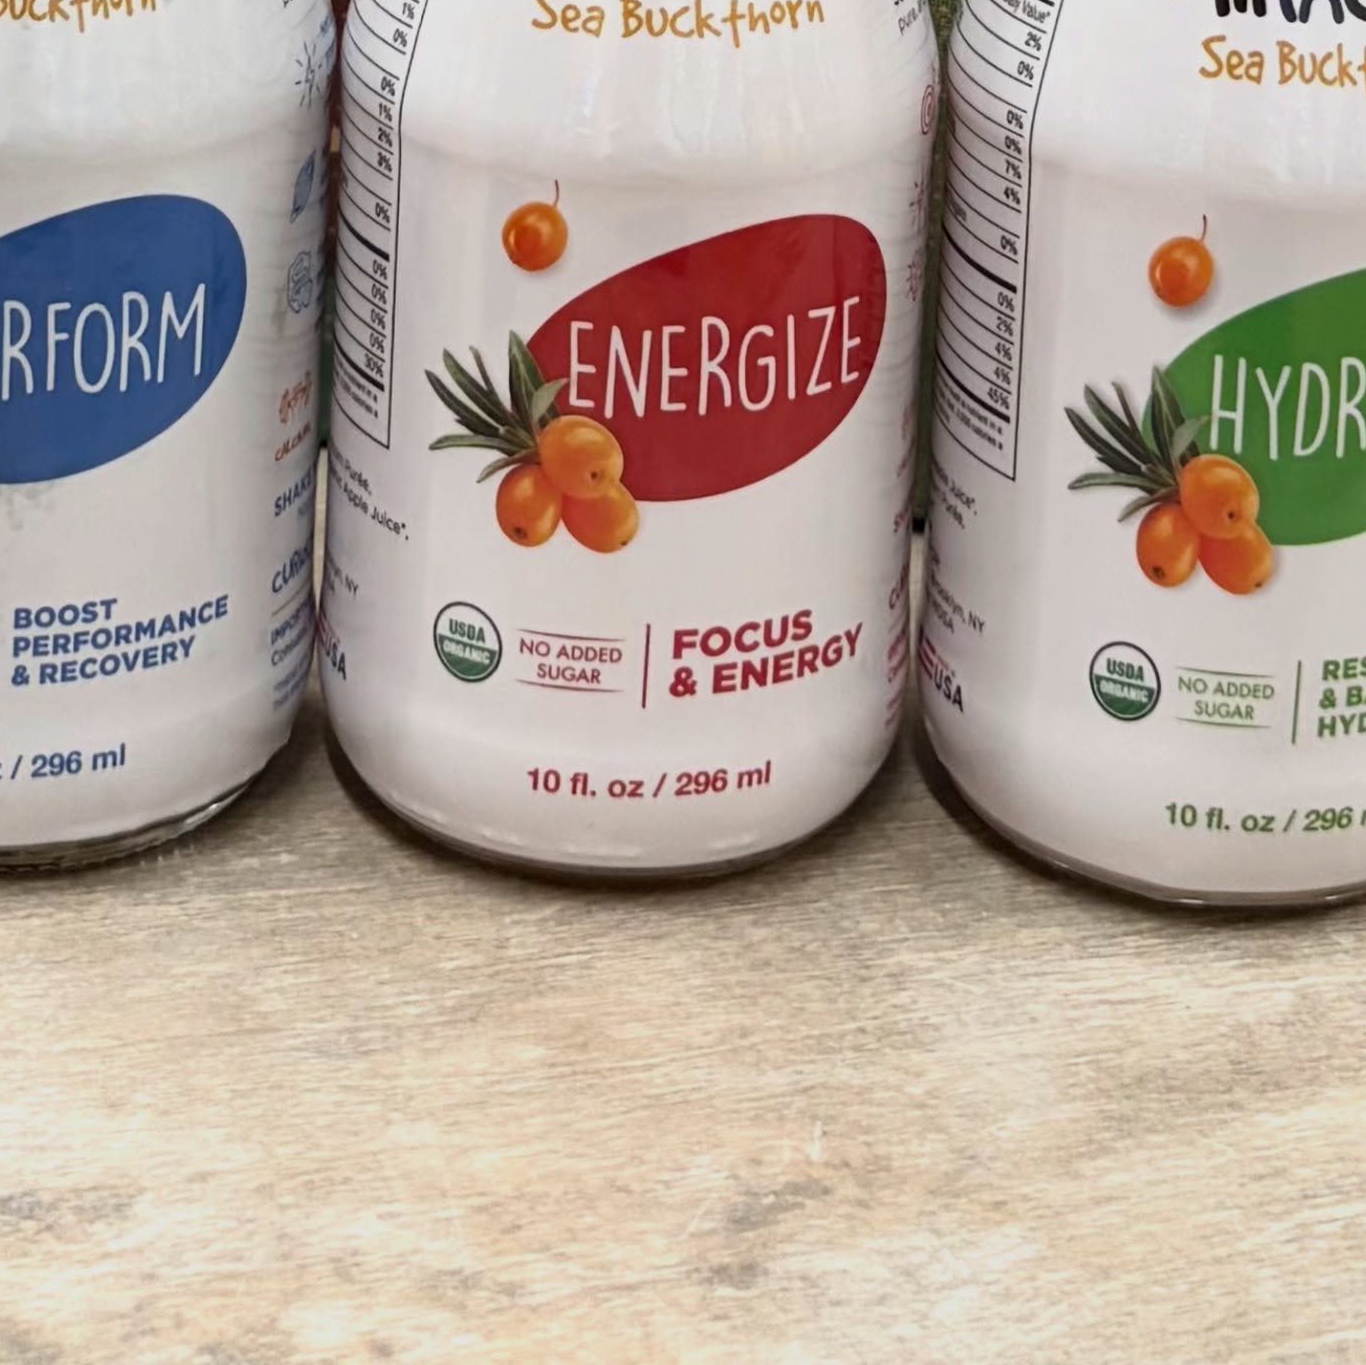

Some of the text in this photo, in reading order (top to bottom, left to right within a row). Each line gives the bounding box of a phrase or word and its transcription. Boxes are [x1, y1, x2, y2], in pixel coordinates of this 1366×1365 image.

[402, 0, 415, 21] 1%
[392, 27, 408, 48] 0%
[1024, 31, 1042, 52] 2%
[1017, 60, 1035, 81] 0%
[1199, 35, 1263, 86] Sea
[380, 75, 396, 97] 0%
[1006, 109, 1024, 130] 0%
[1004, 135, 1022, 156] 0%
[1004, 159, 1022, 180] 7%
[1003, 186, 1021, 206] 4%
[375, 201, 390, 224] 0%
[1000, 235, 1018, 256] 0%
[372, 258, 388, 281] 0%
[371, 283, 387, 305] 0%
[997, 291, 1015, 313] 0%
[370, 308, 386, 330] 0%
[996, 316, 1014, 337] 2%
[369, 332, 385, 355] 0%
[994, 341, 1012, 362] 4%
[568, 296, 862, 419] ENERGIZE
[993, 365, 1011, 386] 4%
[986, 386, 1010, 410] 45%
[13, 598, 118, 629] BOOST
[968, 610, 985, 636] NY
[12, 593, 229, 658] PERFORMANCE
[448, 618, 486, 644] USDA
[672, 609, 813, 660] FOCUS
[11, 634, 196, 686] & RECOVERY
[442, 639, 491, 665] ORGANIC
[519, 637, 623, 663] NO ADDED
[669, 621, 863, 698] & ENERGY
[536, 663, 602, 684] SUGAR
[1107, 657, 1145, 683] USDA
[934, 668, 964, 714] USA
[1099, 679, 1149, 703] ORGANIC
[1177, 675, 1275, 700] NO ADDED
[1319, 687, 1337, 710] &
[1194, 700, 1255, 720] SUGAR
[10, 755, 23, 780] /
[31, 750, 83, 778] 296
[91, 743, 127, 770] ml
[527, 759, 772, 798] 10 fl. oz / 296 ml
[1165, 801, 1197, 827] 10
[1205, 807, 1231, 831] fl.
[1241, 814, 1276, 832] oz
[1283, 809, 1298, 833] /
[1302, 806, 1354, 831] 296
